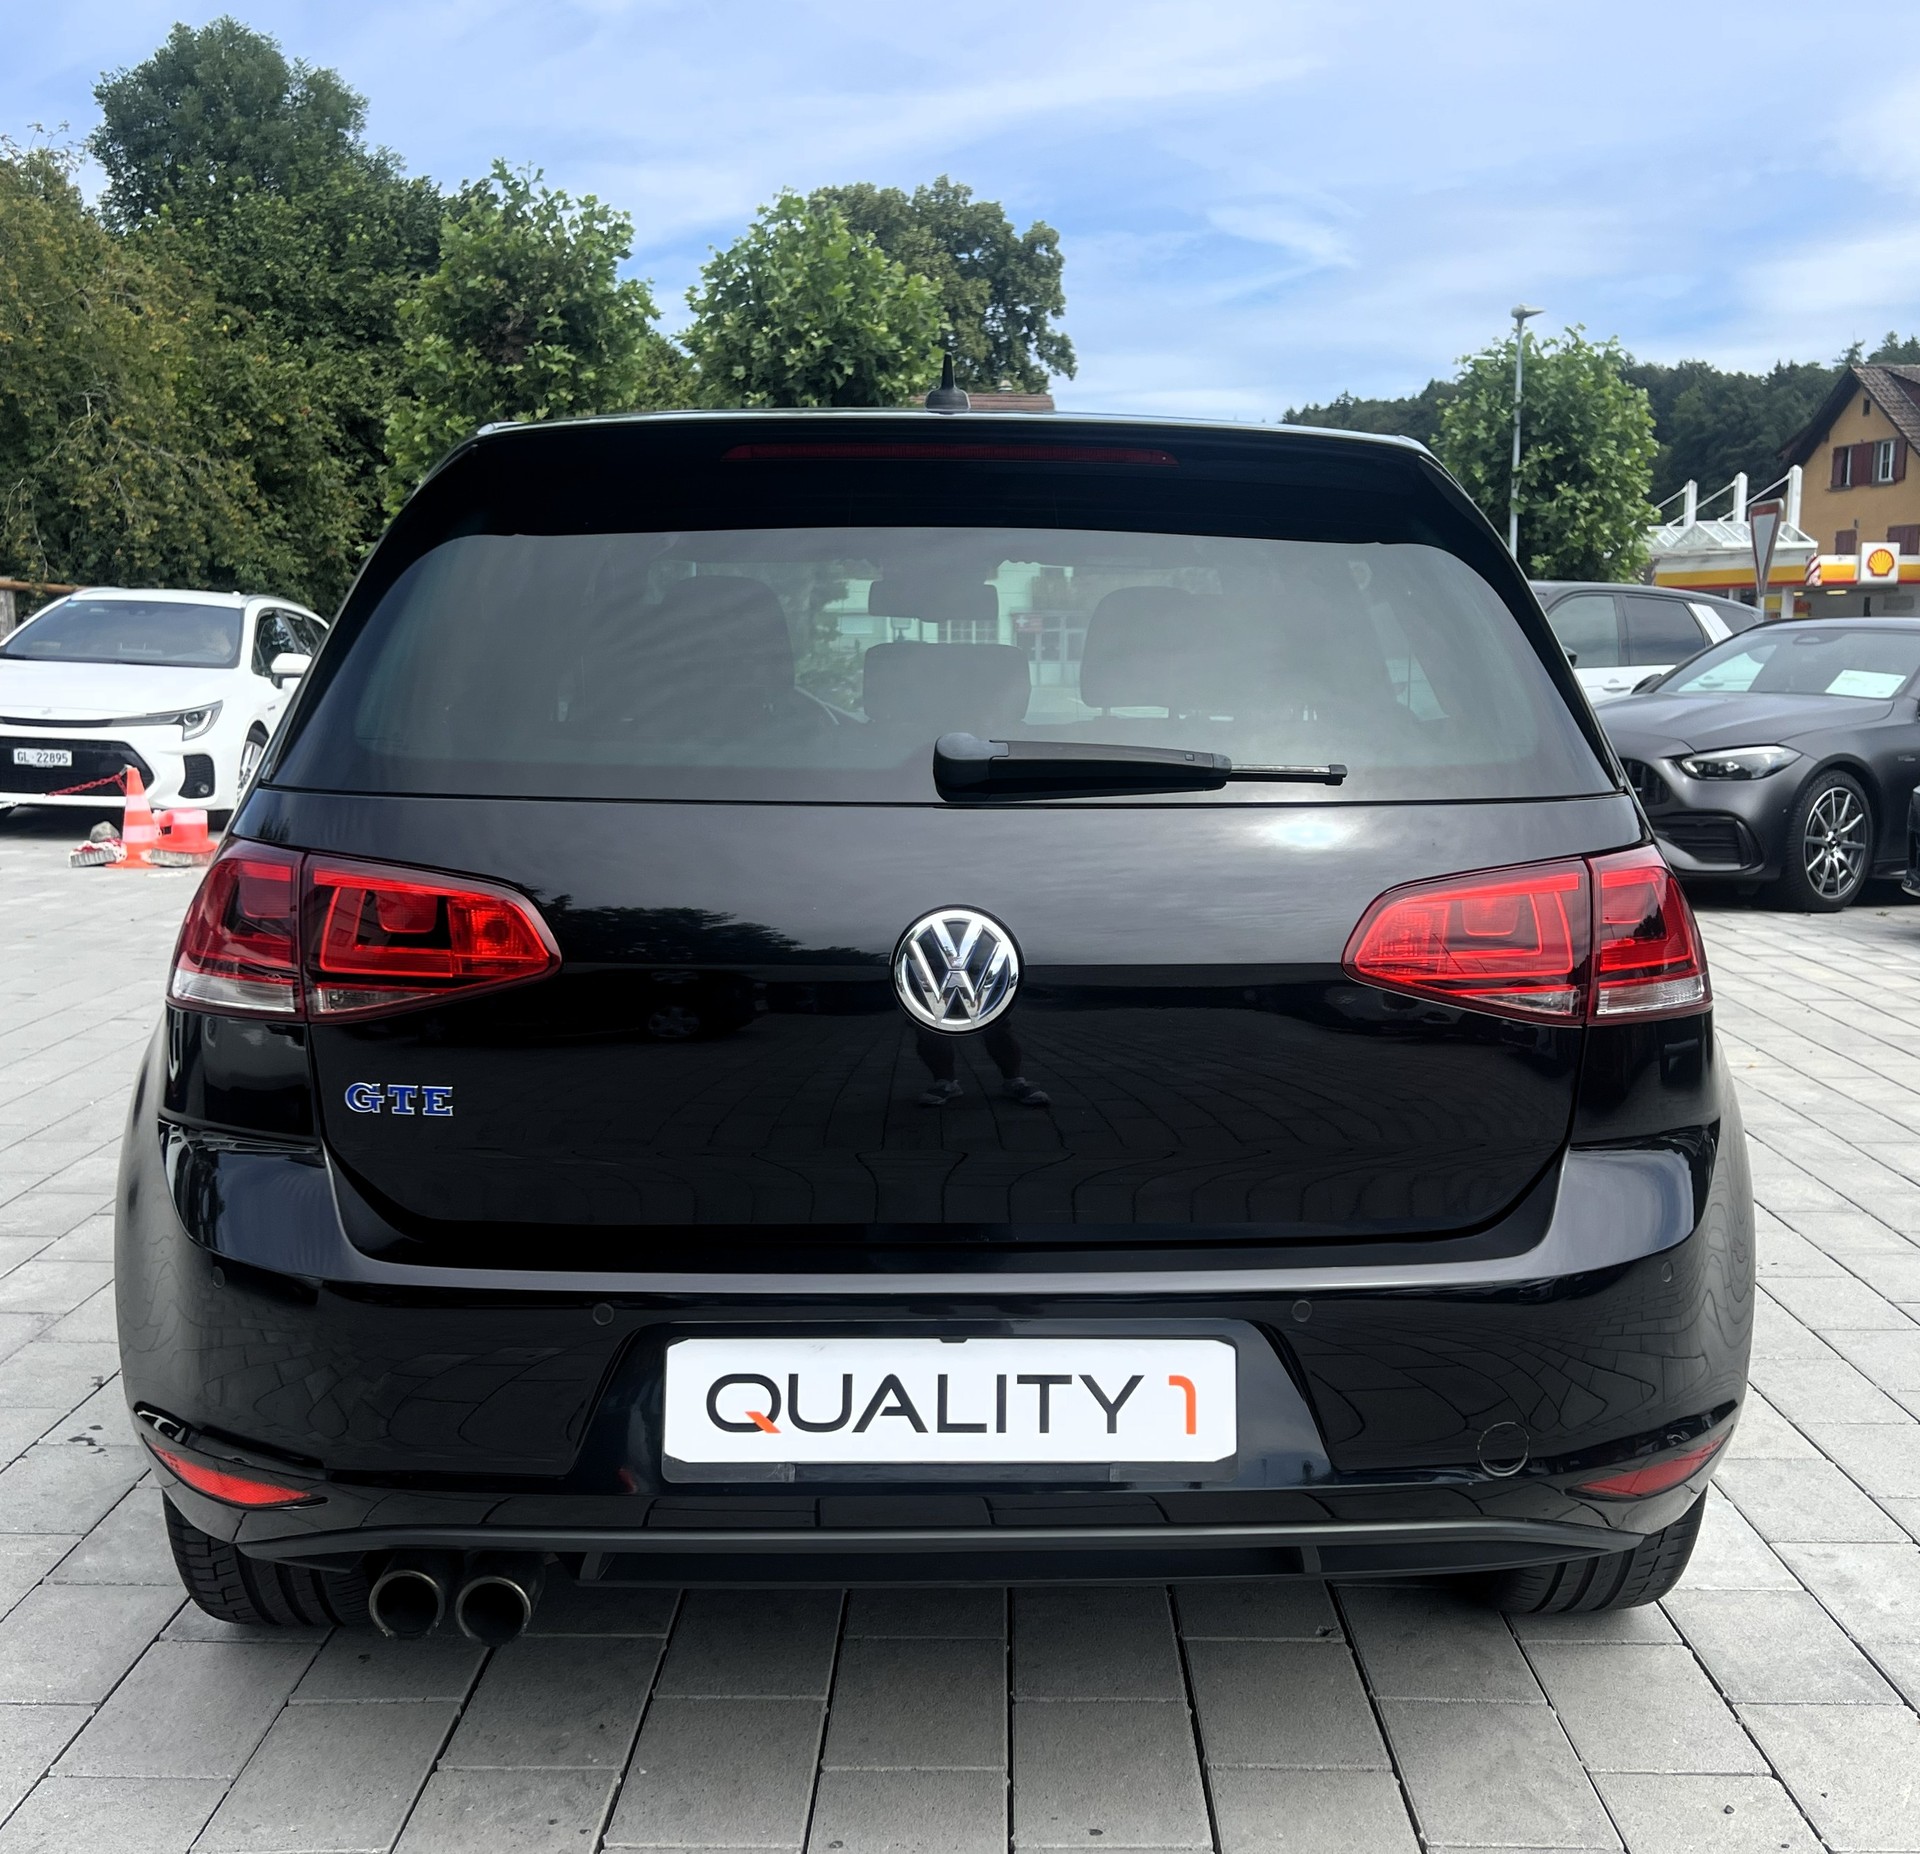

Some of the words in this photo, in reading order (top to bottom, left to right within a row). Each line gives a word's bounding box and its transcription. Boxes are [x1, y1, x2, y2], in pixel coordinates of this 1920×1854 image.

[17, 751, 29, 763] GL
[36, 752, 68, 764] 22895
[894, 910, 1020, 1031] VW
[345, 1082, 454, 1116] GTE
[706, 1373, 1144, 1434] QUALITY
[1168, 1375, 1196, 1434] 1
